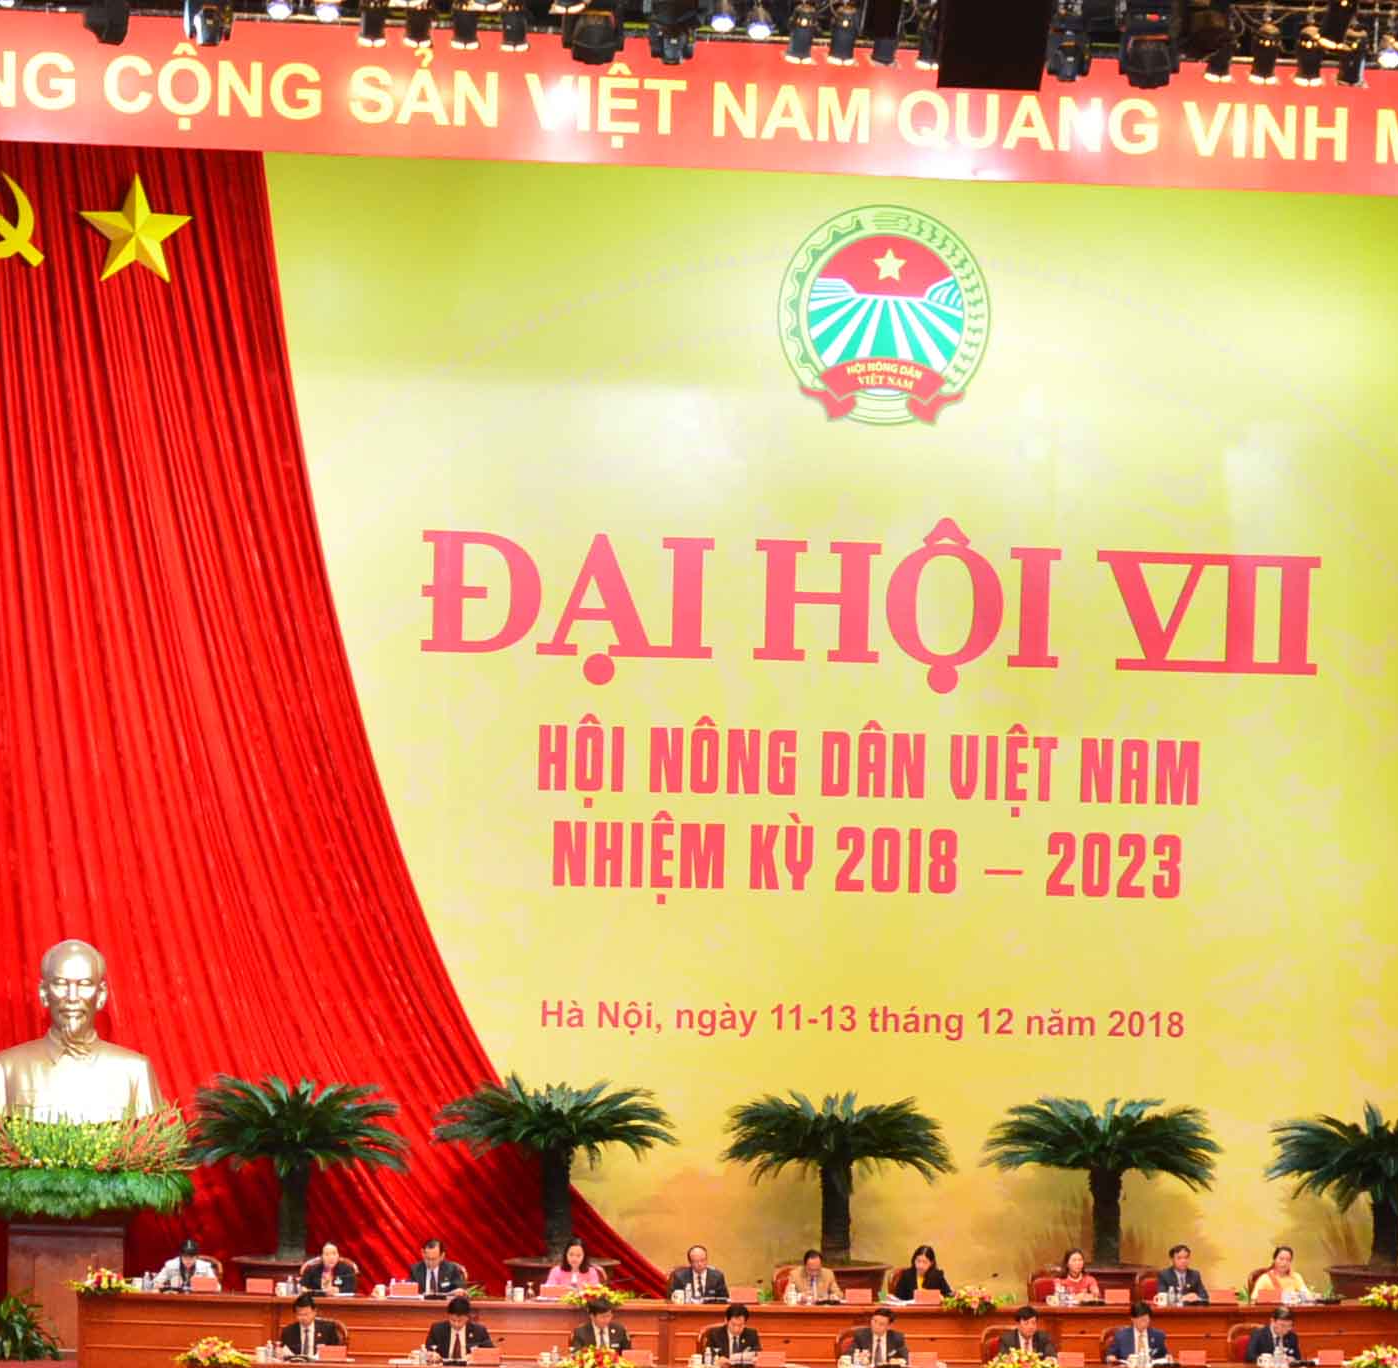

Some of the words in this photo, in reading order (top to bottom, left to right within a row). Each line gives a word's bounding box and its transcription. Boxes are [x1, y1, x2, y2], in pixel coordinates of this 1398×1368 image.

[104, 43, 322, 130] CỘNG
[349, 48, 499, 127] SẢN
[526, 62, 687, 148] VIỆT
[712, 83, 871, 144] NAM
[897, 90, 1160, 155] QUANG
[1183, 101, 1348, 161] VINH
[421, 530, 714, 685] ĐẠI
[753, 517, 1062, 694] HỘI
[1097, 550, 1321, 675] VII
[539, 713, 624, 808] HỘI
[649, 715, 797, 796] NÔNG
[821, 720, 925, 799] DÂN
[950, 723, 1058, 817] VIỆT
[1080, 737, 1199, 806] NAM
[552, 810, 724, 905] NHIỆM
[749, 813, 814, 891] KỲ
[835, 826, 957, 894] 2018
[1046, 832, 1182, 898] 2023
[540, 1000, 584, 1029] Hà
[597, 1001, 662, 1035] Nội,
[676, 1002, 757, 1037] ngày
[770, 1003, 857, 1032] 11-13
[868, 1005, 964, 1041] tháng
[977, 1008, 1013, 1035] 12
[1026, 1009, 1096, 1037] năm
[1108, 1010, 1185, 1039] 2018
